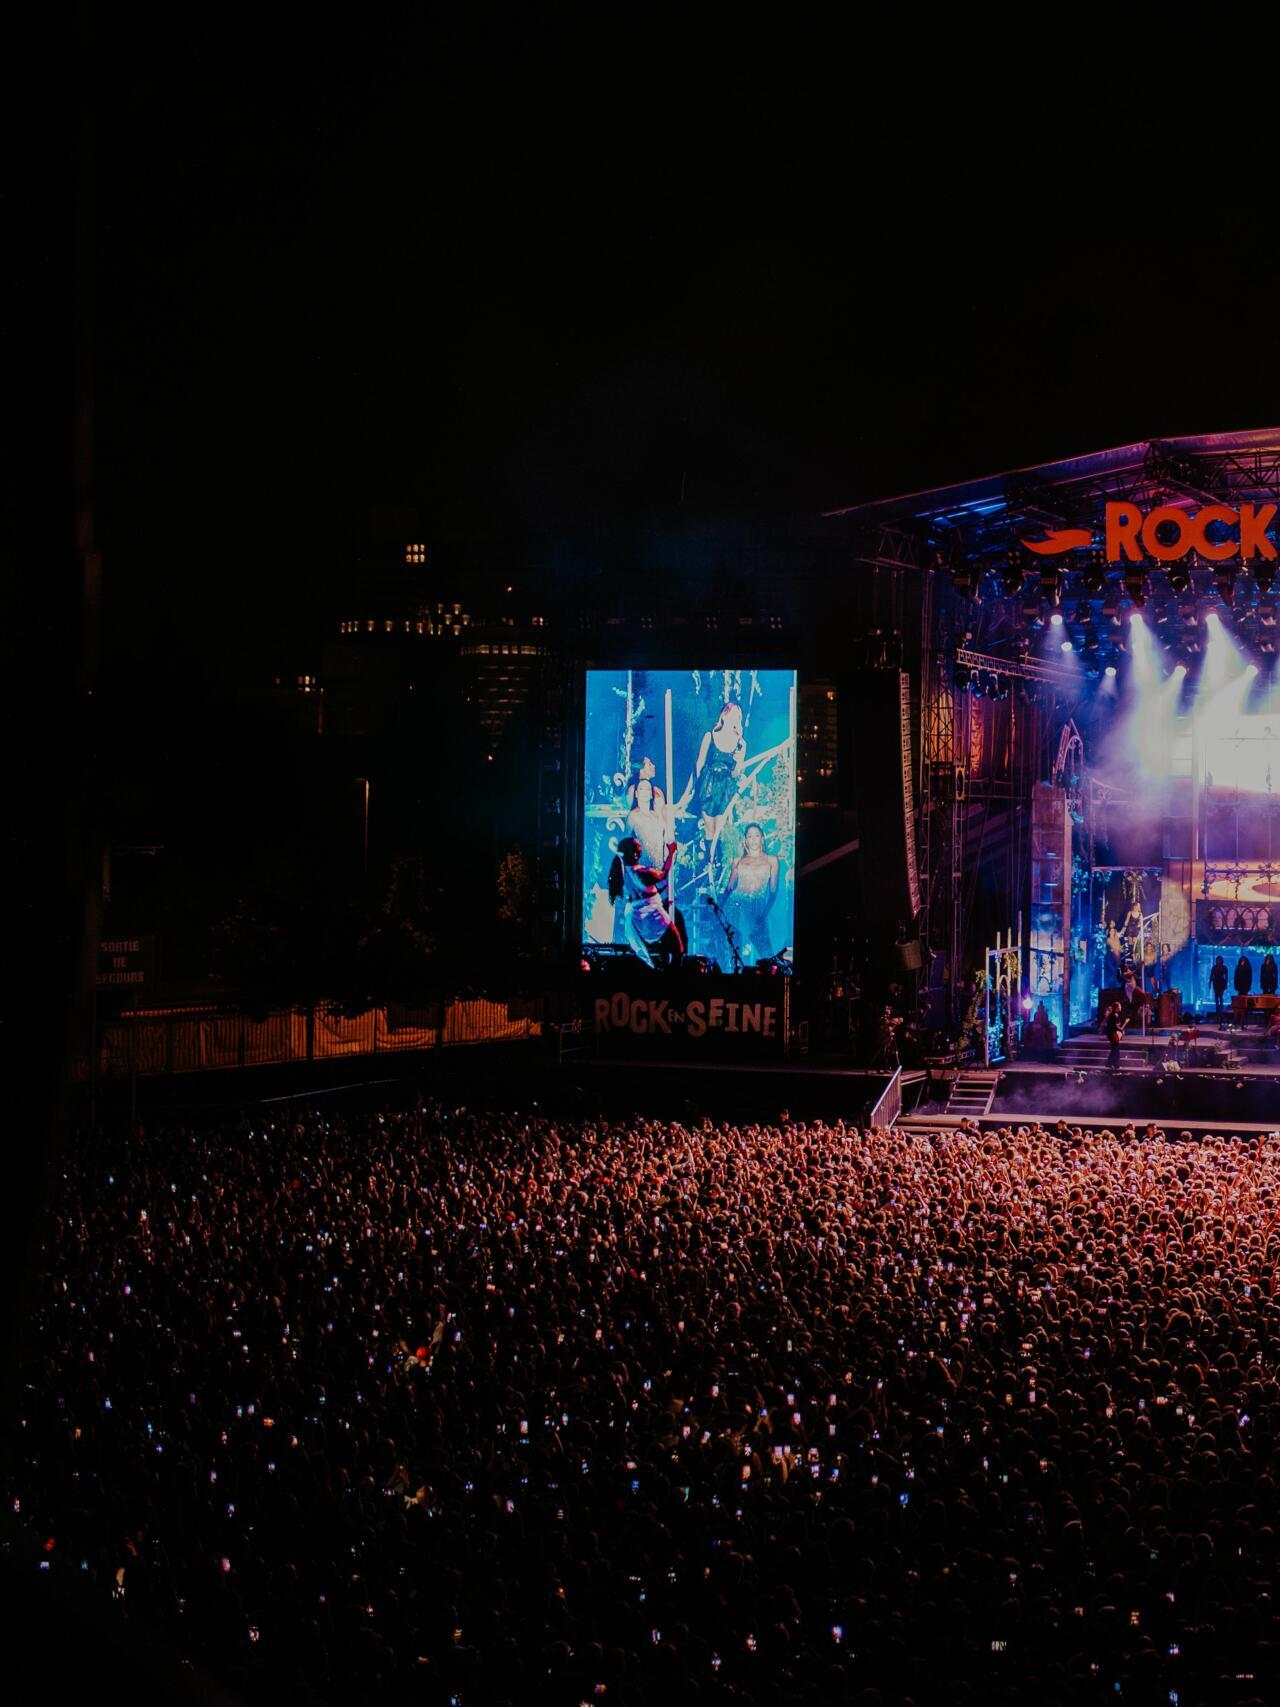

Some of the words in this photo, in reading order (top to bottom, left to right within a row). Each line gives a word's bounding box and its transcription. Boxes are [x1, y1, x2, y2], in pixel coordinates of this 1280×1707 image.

[1105, 500, 1279, 562] ROCK
[593, 991, 673, 1036] ROCK
[666, 1007, 686, 1025] EN
[685, 997, 777, 1039] SEINE
